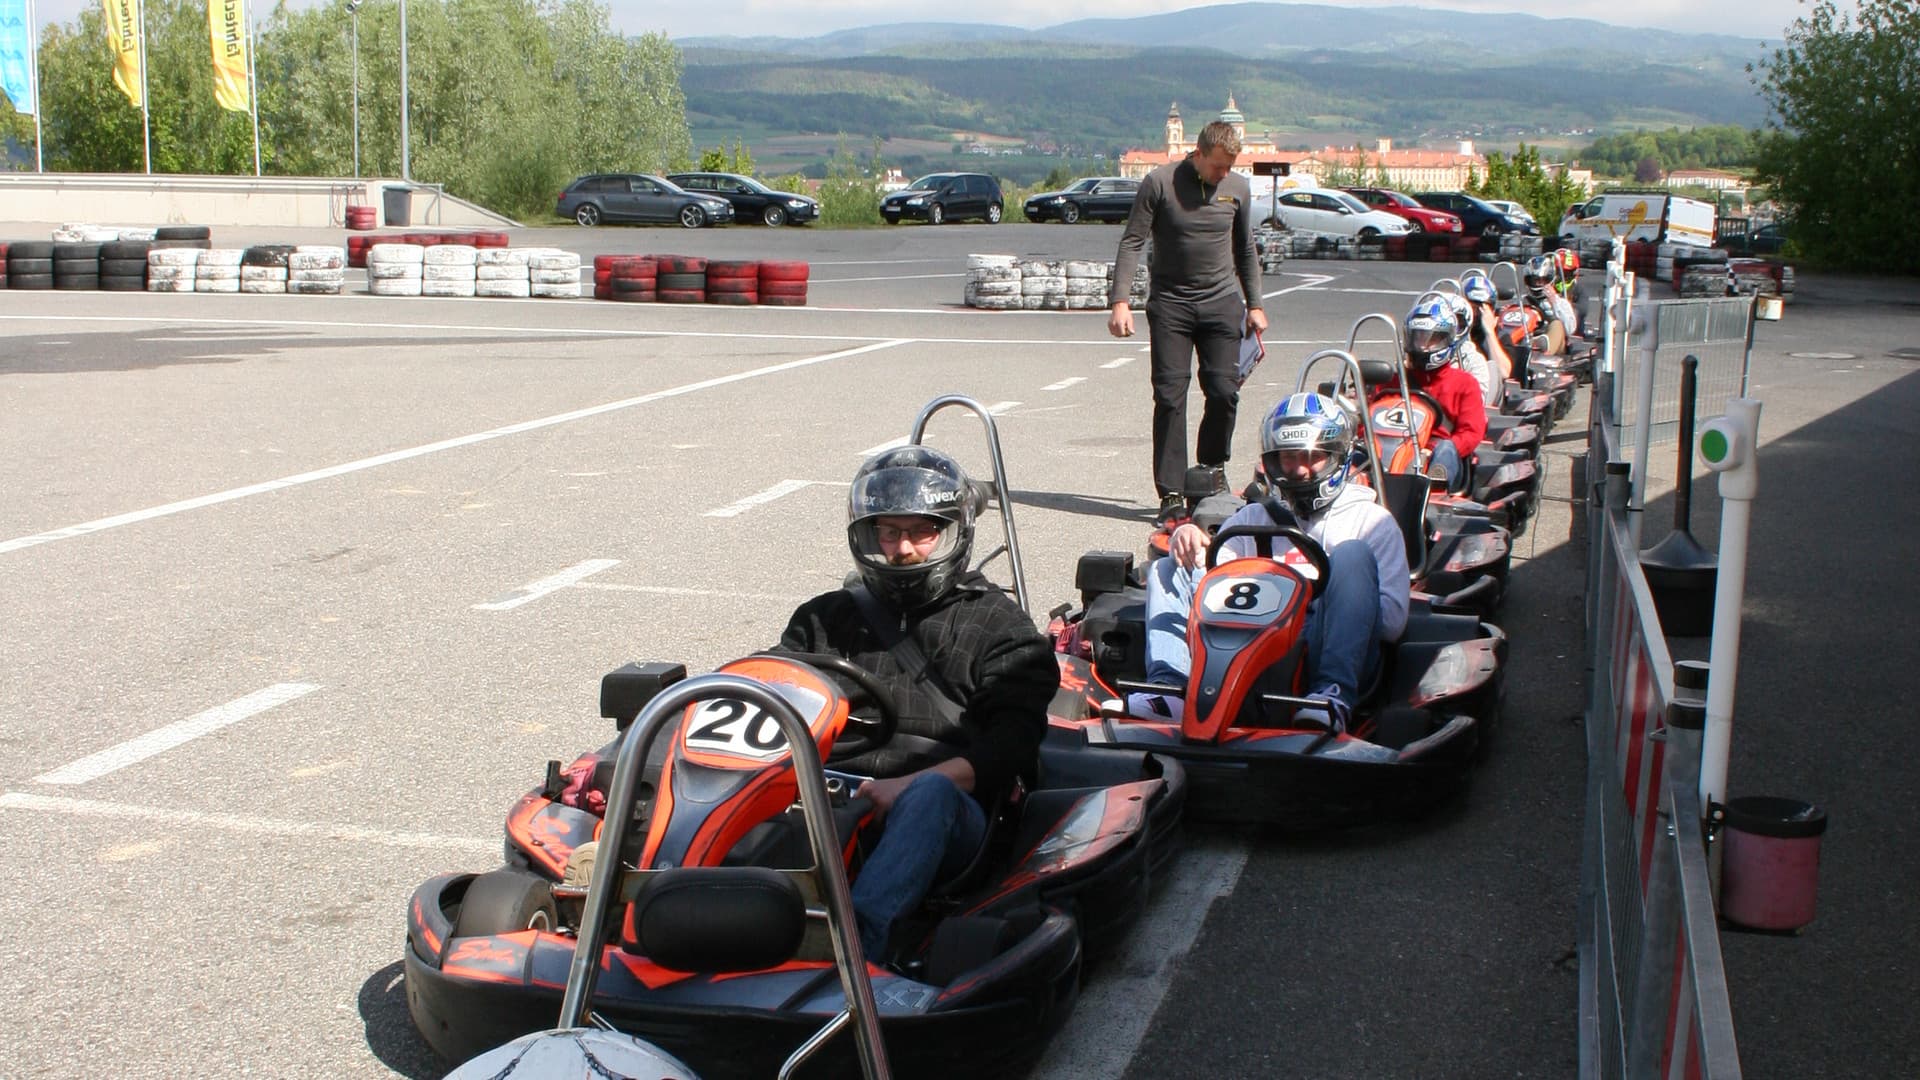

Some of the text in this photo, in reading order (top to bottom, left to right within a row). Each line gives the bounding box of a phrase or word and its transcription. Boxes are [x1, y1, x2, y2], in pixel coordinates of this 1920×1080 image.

[1387, 411, 1405, 424] 4
[1281, 429, 1309, 440] SHOEI
[924, 490, 957, 505] uvex
[1224, 582, 1261, 610] 8
[687, 698, 789, 751] 20
